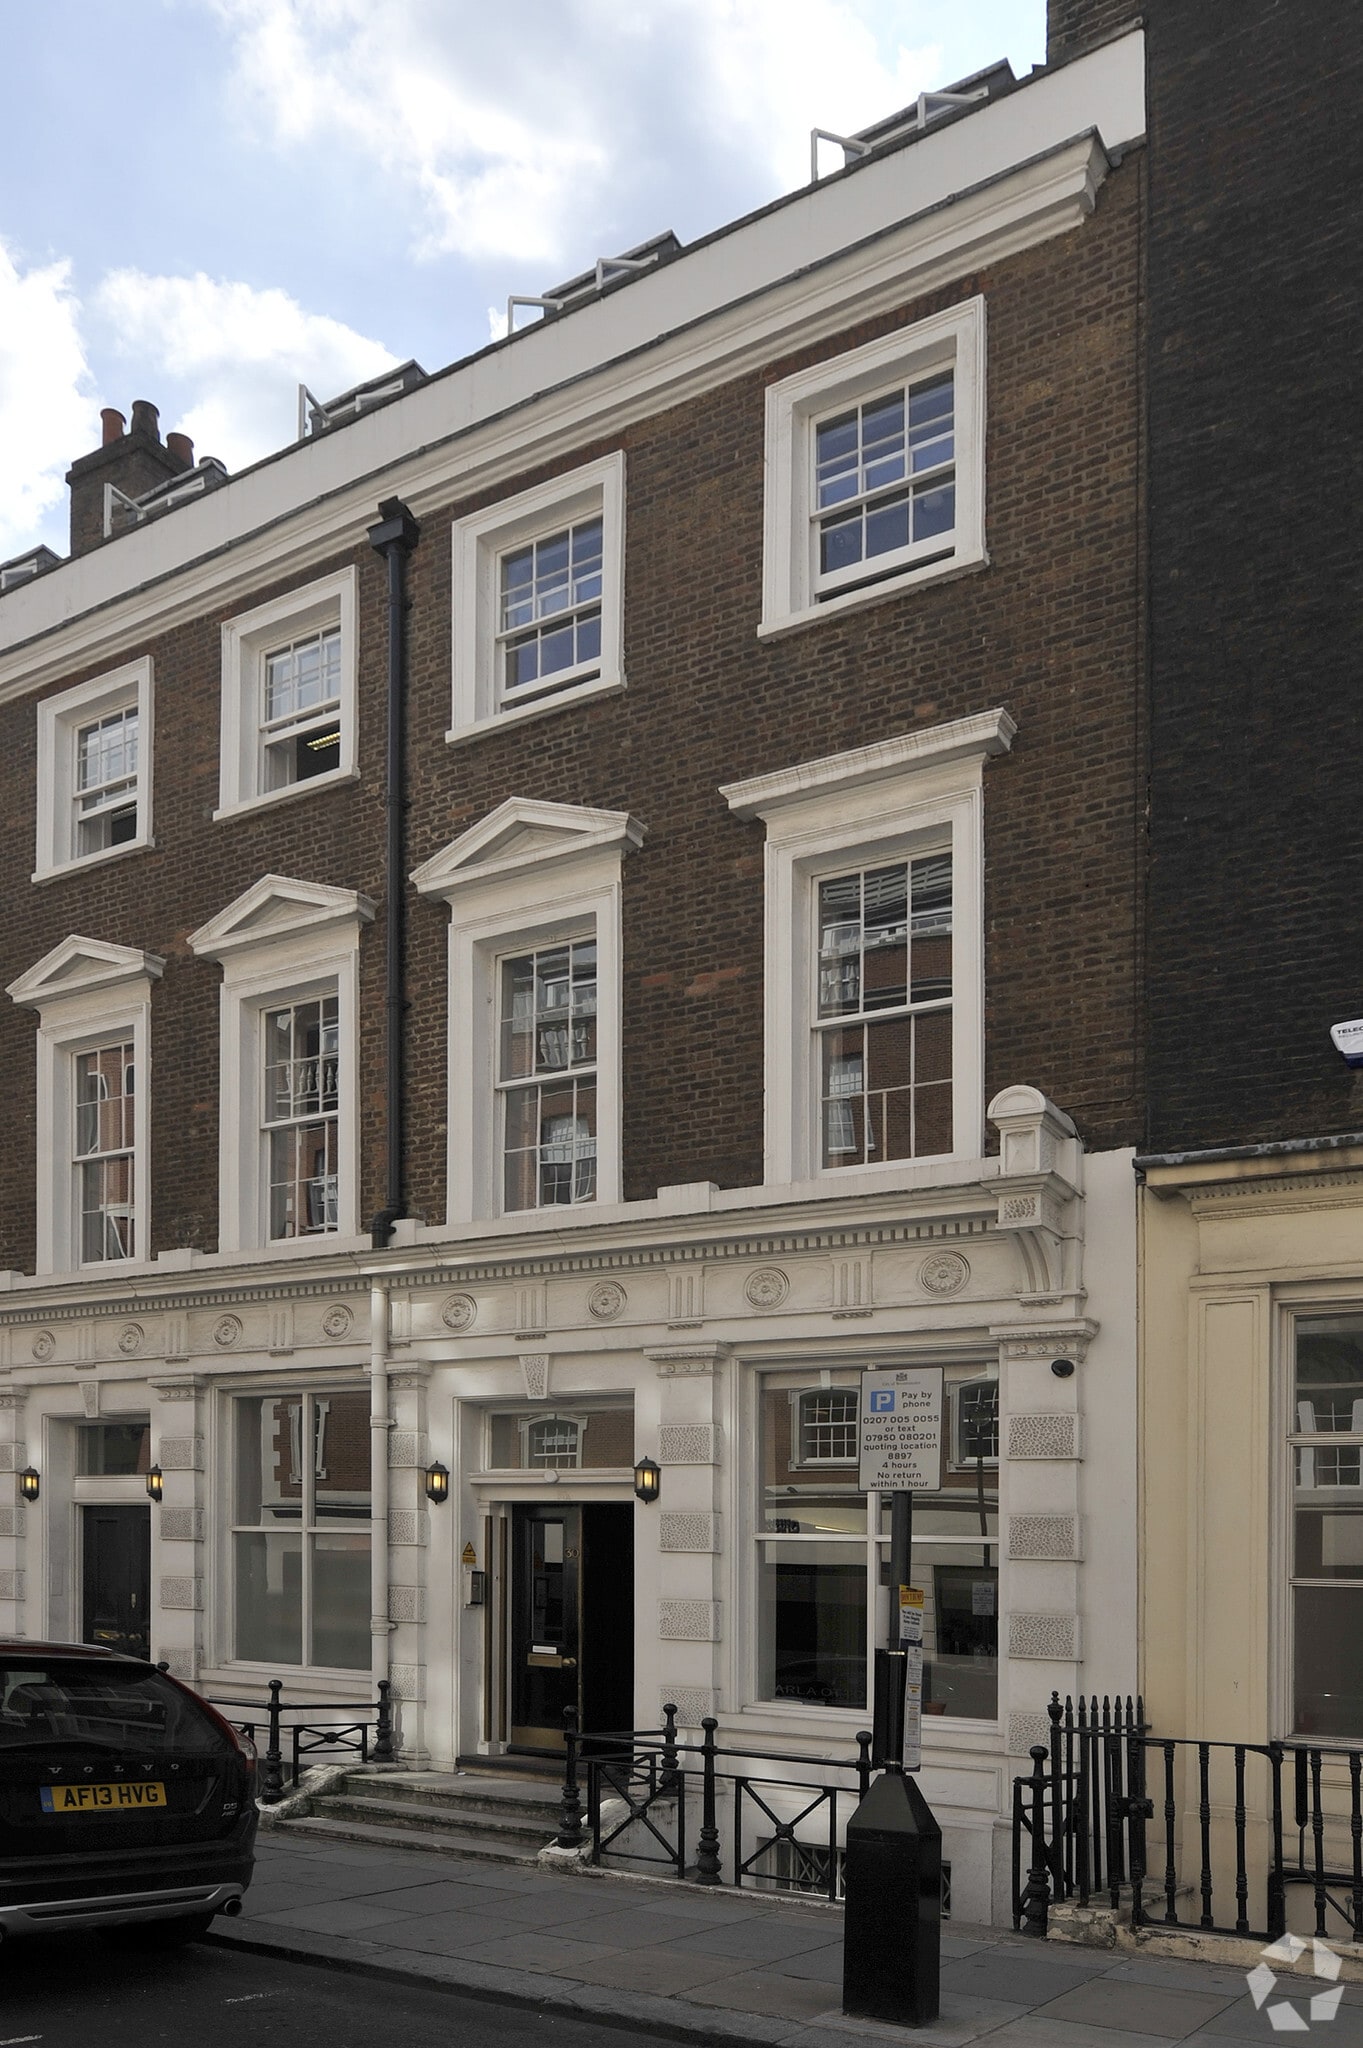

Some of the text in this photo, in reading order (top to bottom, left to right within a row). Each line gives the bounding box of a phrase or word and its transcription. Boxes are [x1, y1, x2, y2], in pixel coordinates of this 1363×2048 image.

[902, 1391, 932, 1400] Pay by
[876, 1393, 892, 1411] P
[903, 1401, 931, 1409] phone
[863, 1415, 939, 1425] 0207 005 0055
[865, 1433, 936, 1442] 07950 080201
[863, 1442, 938, 1451] quoting location
[888, 1452, 912, 1460] 8897
[893, 1471, 922, 1479] return
[870, 1480, 898, 1488] within
[564, 1546, 580, 1559] 30
[48, 1763, 180, 1774] VOLVO
[63, 1784, 159, 1807] AF13 HVG
